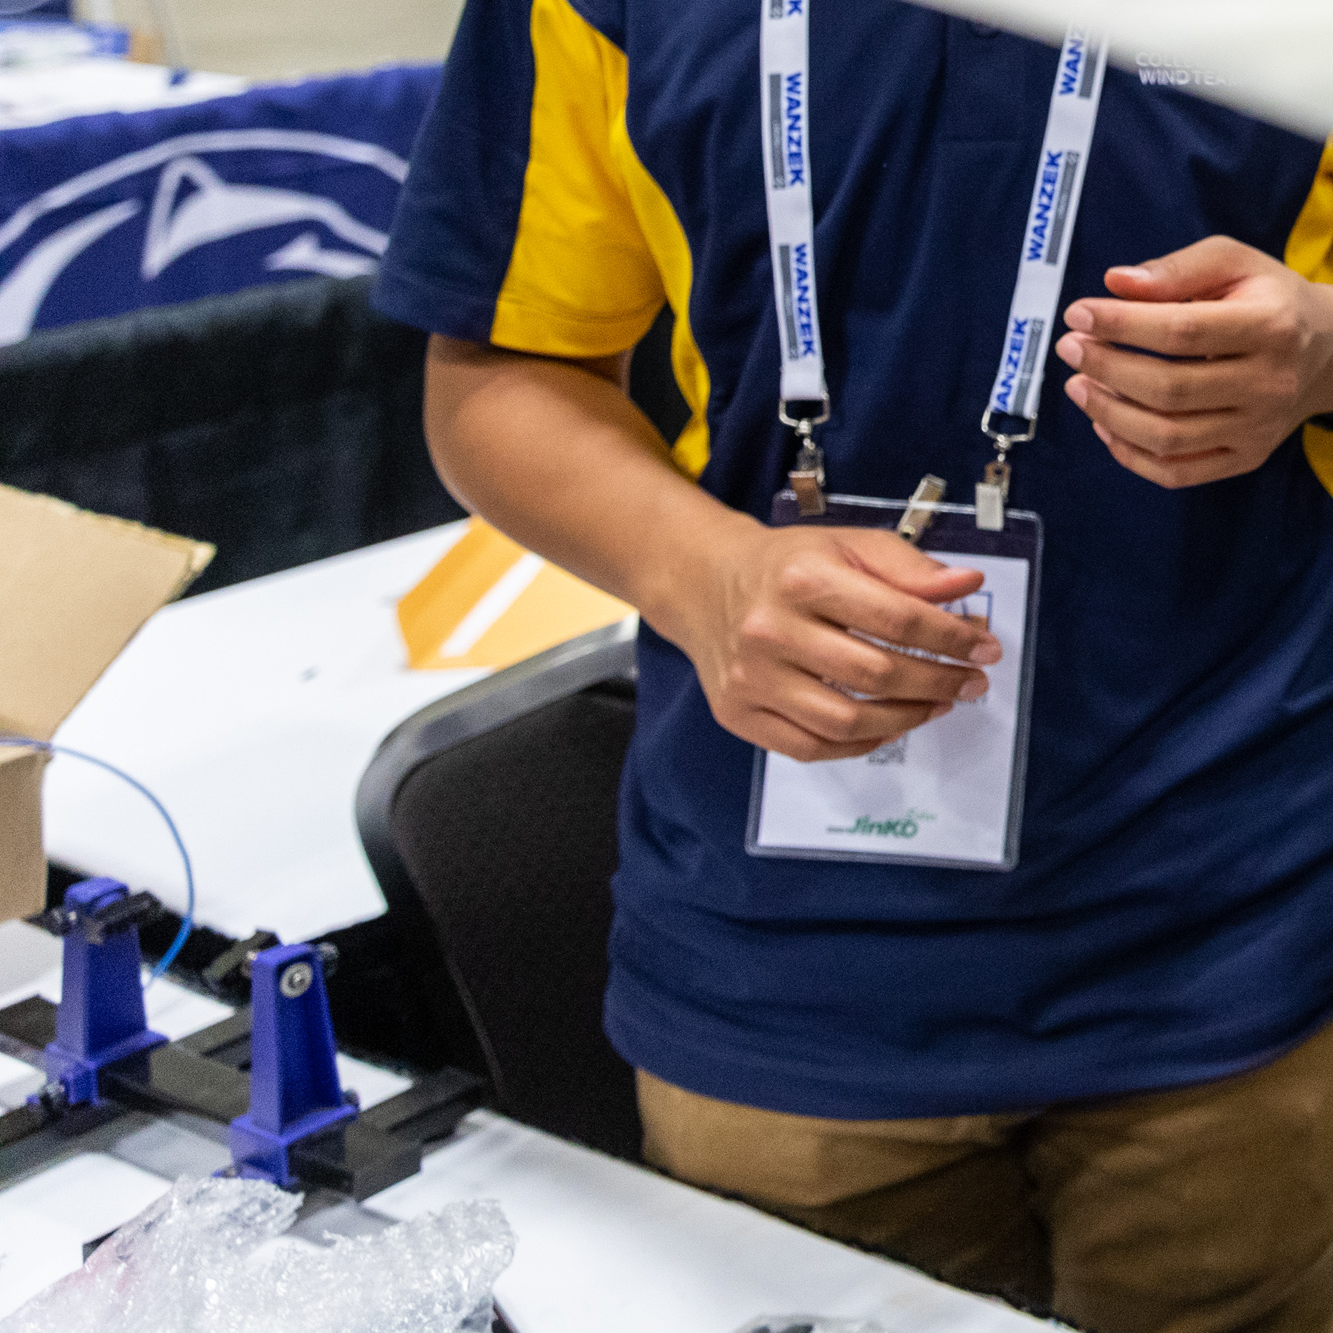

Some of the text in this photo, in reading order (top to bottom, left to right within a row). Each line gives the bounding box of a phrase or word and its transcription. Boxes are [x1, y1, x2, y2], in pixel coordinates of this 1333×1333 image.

[785, 72, 805, 186] WANZEK
[1026, 150, 1063, 261] WANZEK
[792, 243, 816, 358] WANZEK
